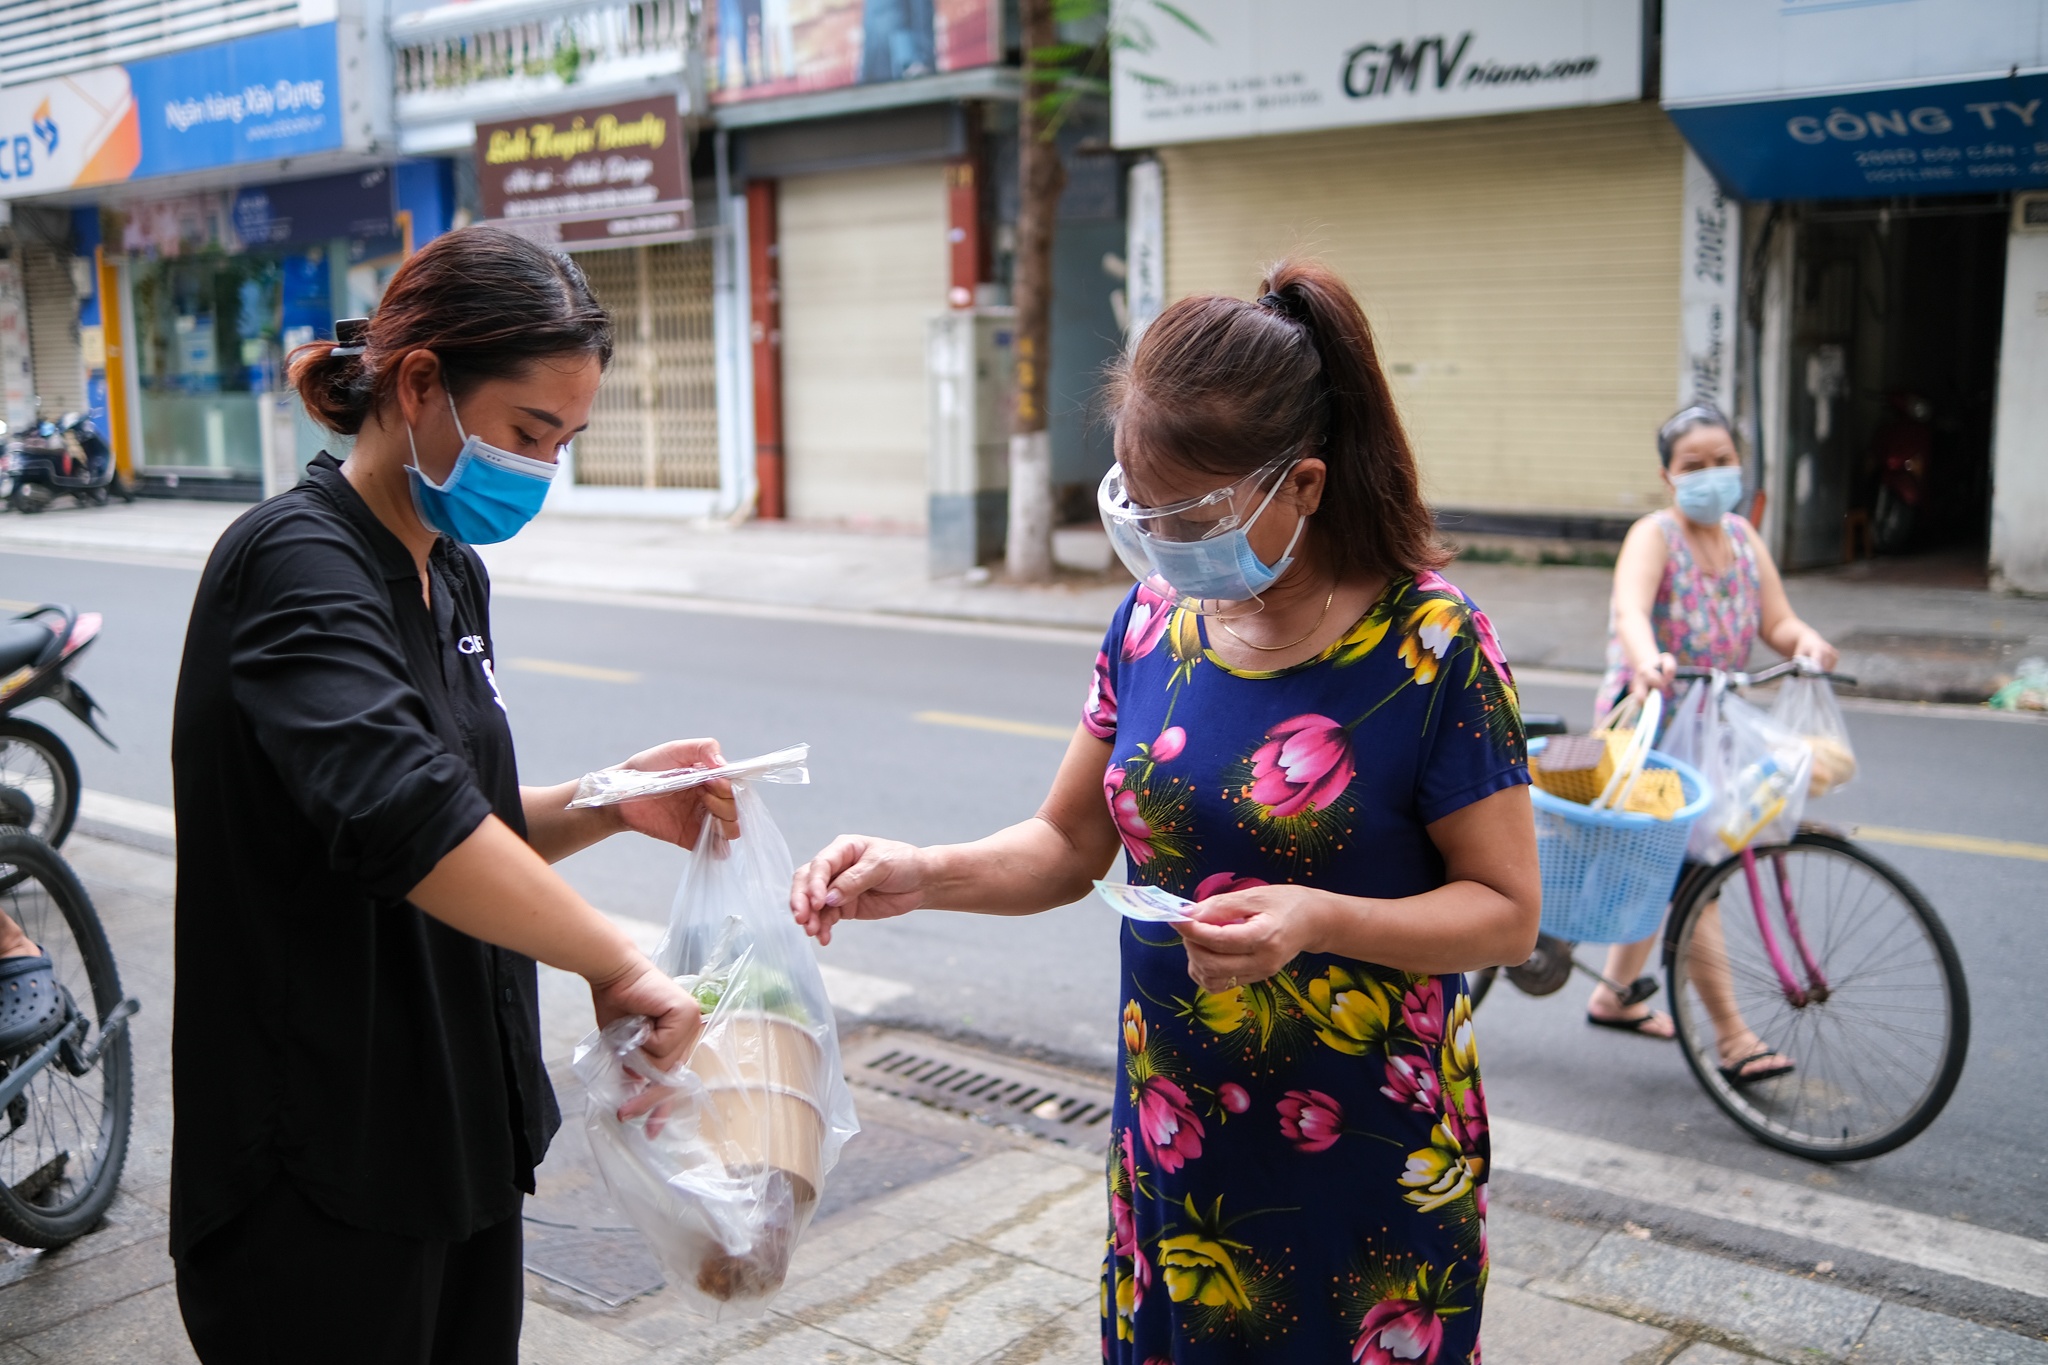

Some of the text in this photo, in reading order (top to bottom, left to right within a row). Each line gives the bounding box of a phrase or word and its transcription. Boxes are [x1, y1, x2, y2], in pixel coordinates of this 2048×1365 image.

[1342, 31, 1475, 99] GMV
[1786, 98, 2043, 145] CÔNG TY
